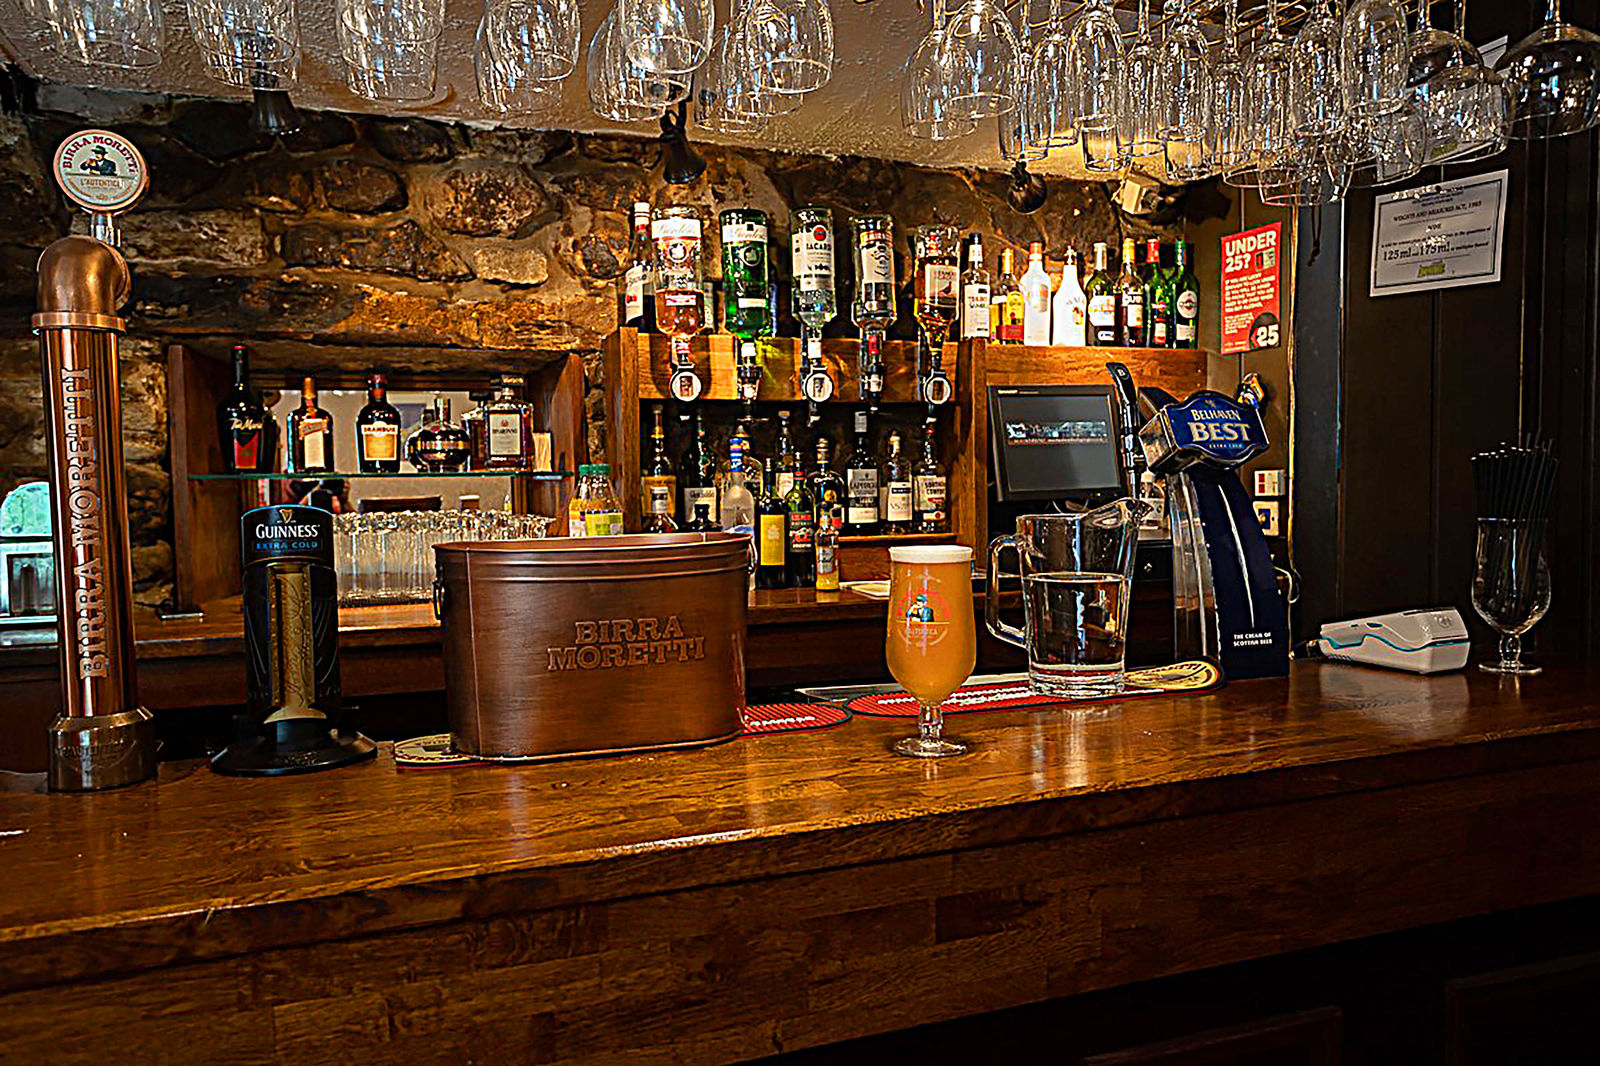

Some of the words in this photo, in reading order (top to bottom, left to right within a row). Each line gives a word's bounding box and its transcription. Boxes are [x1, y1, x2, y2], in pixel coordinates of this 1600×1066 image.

[62, 137, 91, 169] BIRRA
[92, 136, 138, 173] MORETTI
[1224, 230, 1276, 256] UNDER
[1224, 252, 1251, 272] 25?
[1256, 324, 1279, 347] 25
[1190, 410, 1241, 421] BELHAVEN
[1187, 422, 1250, 442] BEST
[62, 368, 100, 547] MORETTI
[256, 524, 318, 539] GUINNESS
[256, 541, 288, 550] EXTRA
[74, 557, 108, 679] BIRRA
[575, 615, 684, 644] BIRRA
[548, 636, 704, 671] MORETTI
